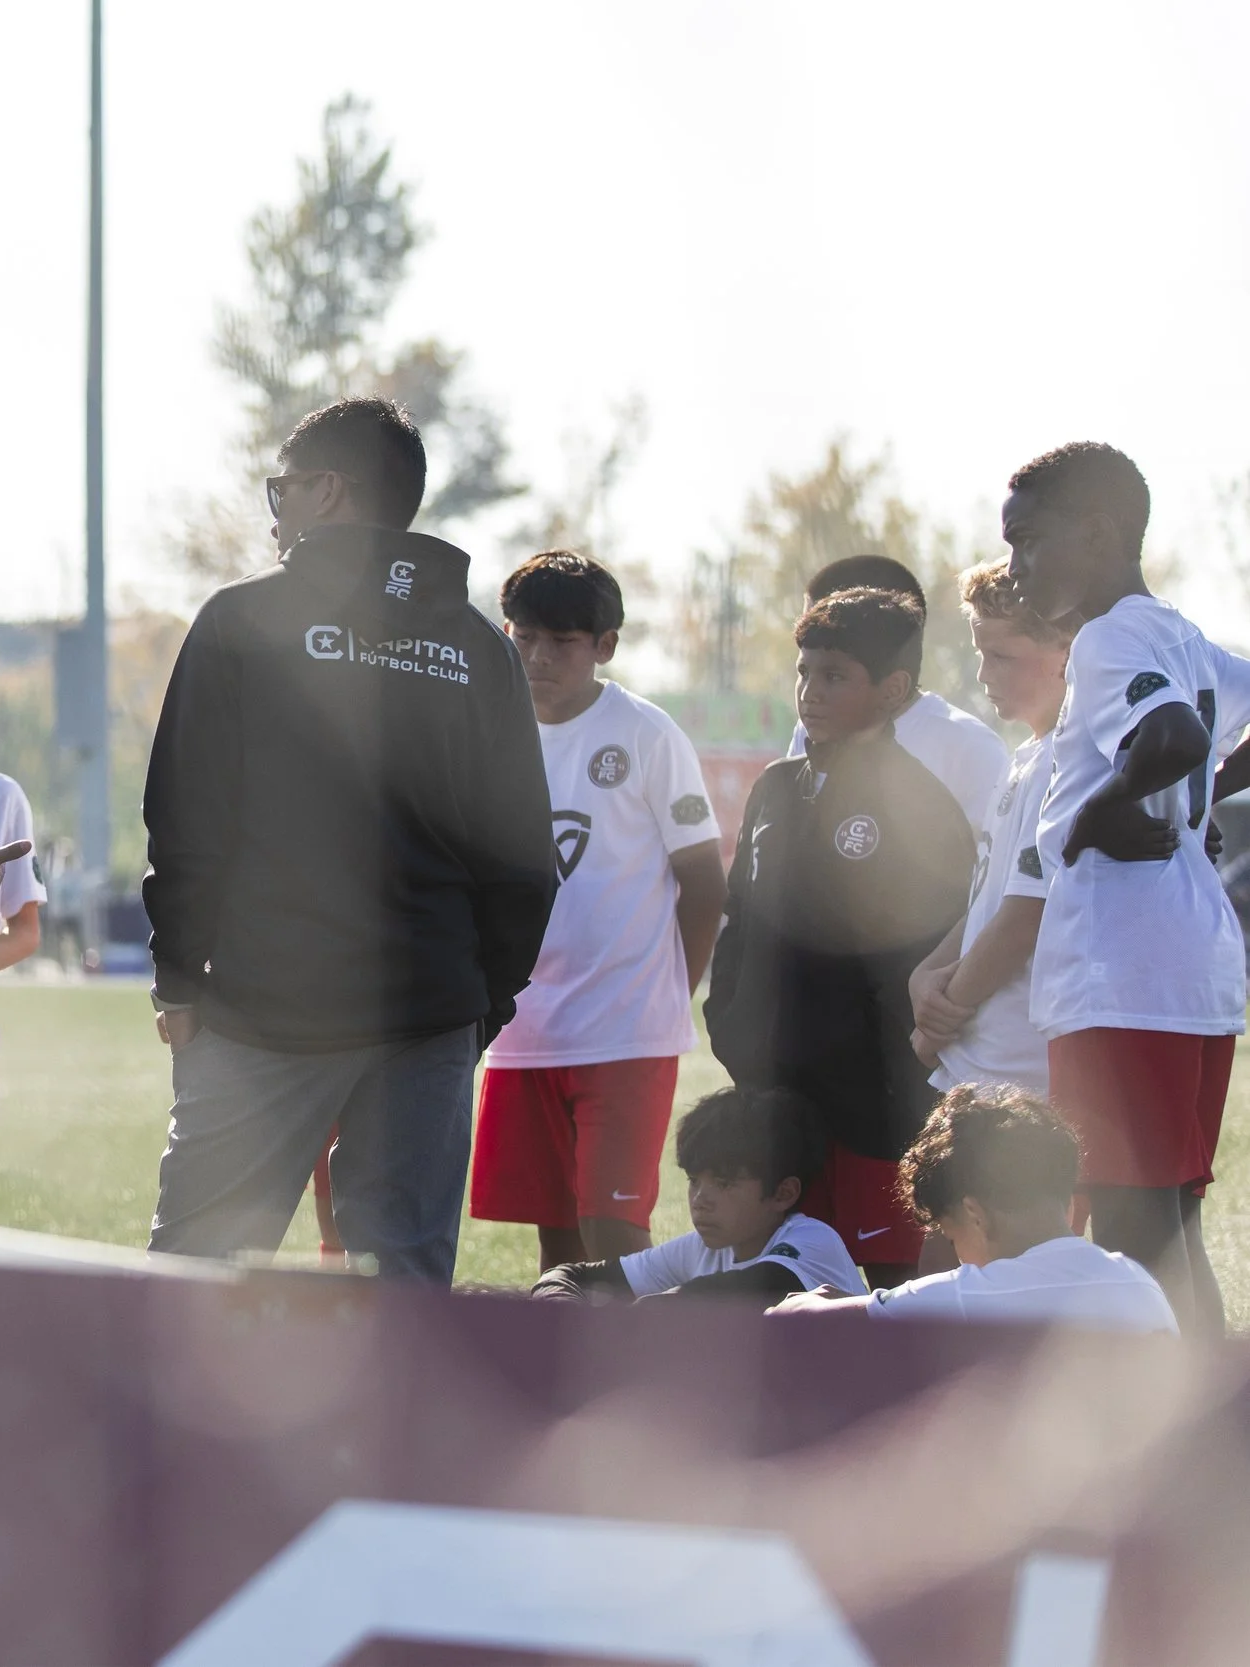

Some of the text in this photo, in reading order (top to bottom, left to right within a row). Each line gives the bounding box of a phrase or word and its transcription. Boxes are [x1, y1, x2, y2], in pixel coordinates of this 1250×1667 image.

[385, 584, 411, 600] FC
[358, 635, 469, 669] APITAL
[360, 650, 469, 684] FÚTBOL CLUB
[843, 840, 863, 853] FC
